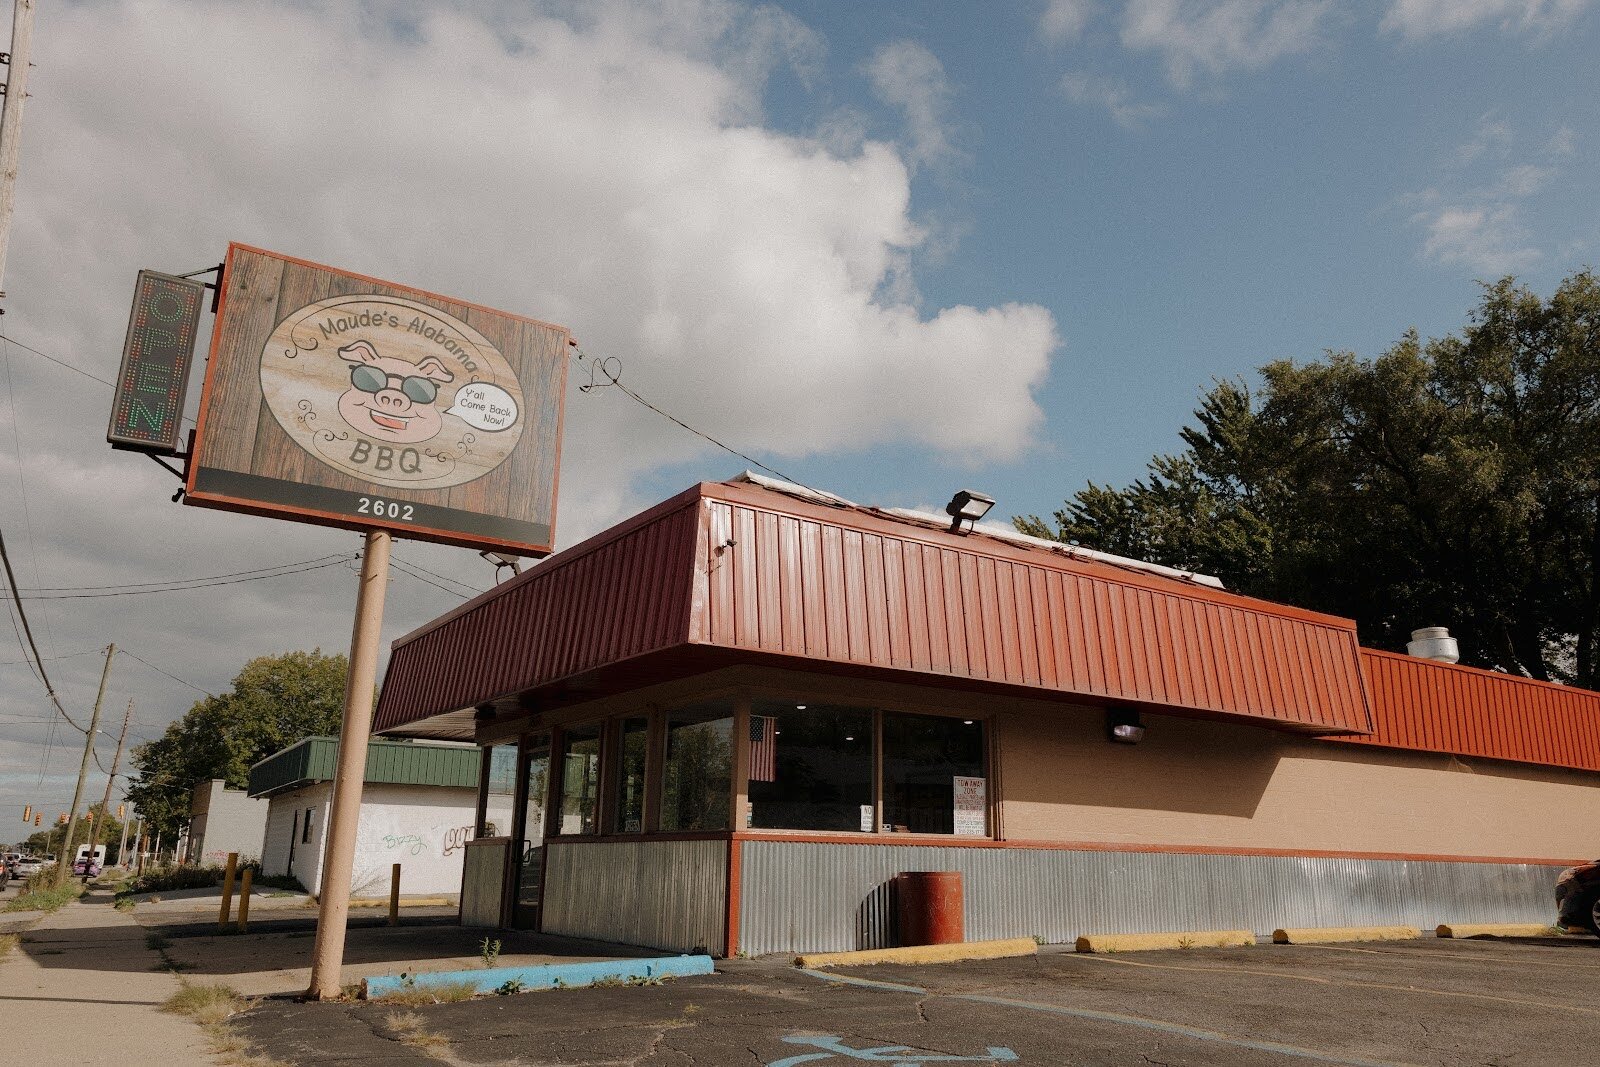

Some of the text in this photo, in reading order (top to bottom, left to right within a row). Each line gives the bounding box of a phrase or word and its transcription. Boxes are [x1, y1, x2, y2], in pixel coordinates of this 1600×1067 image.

[318, 309, 479, 374] Maude's Alabama
[128, 291, 184, 432] OPEN
[465, 388, 485, 400] Y'all
[460, 398, 511, 417] Come Back
[483, 414, 505, 426] Now!
[349, 438, 423, 473] BBQ
[357, 497, 414, 520] 2602
[969, 780, 983, 788] AWAY
